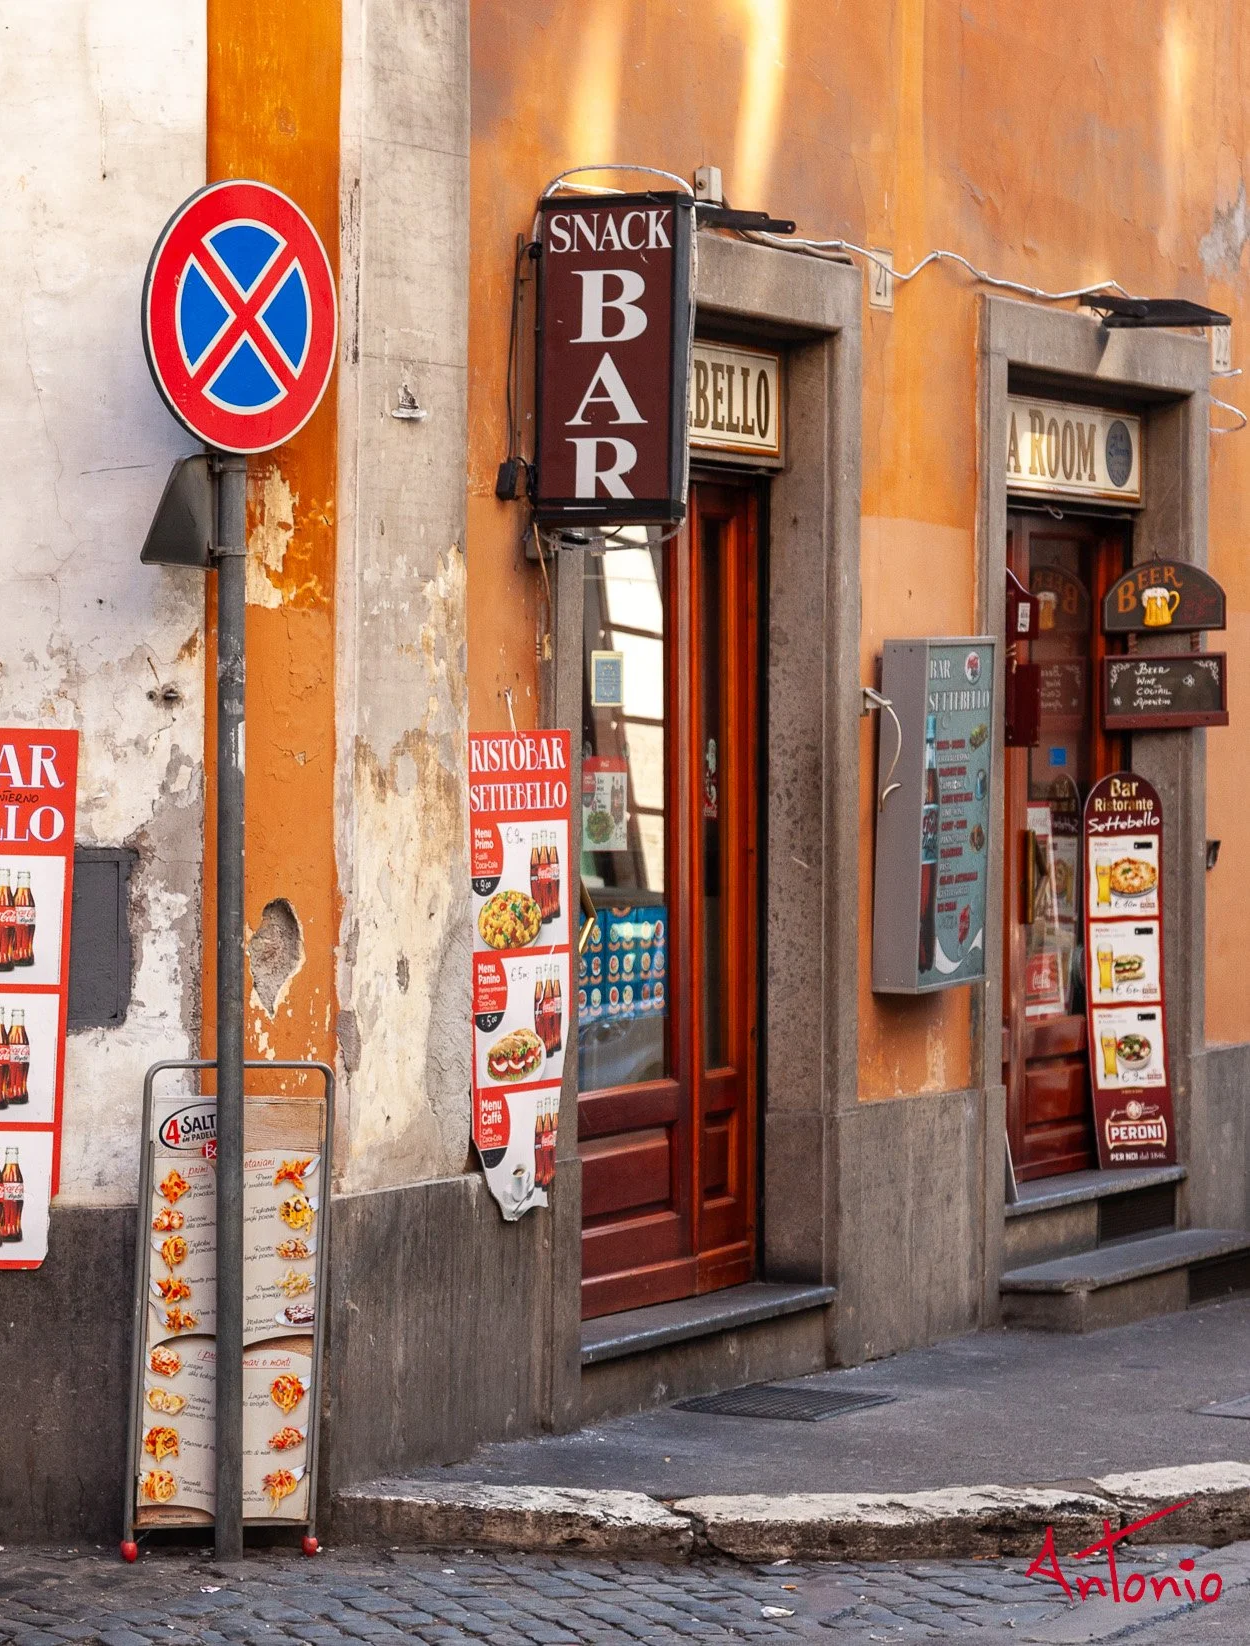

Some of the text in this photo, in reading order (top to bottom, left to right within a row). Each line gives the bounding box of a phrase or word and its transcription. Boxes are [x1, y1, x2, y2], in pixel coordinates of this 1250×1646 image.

[550, 209, 672, 254] SNACK
[564, 269, 648, 509] BAR
[687, 359, 770, 439] BELLO
[1029, 408, 1097, 482] ROOM
[1117, 566, 1183, 613] BEER
[930, 659, 951, 679] BAR
[1110, 778, 1139, 797] Bar
[470, 781, 568, 813] SETTEBELLO
[1094, 798, 1154, 812] Ristorante
[1088, 812, 1160, 834] Settebello
[474, 828, 492, 839] Menu
[475, 839, 494, 850] Primo
[475, 861, 498, 870] Coca-Cola
[477, 963, 496, 974] Menu
[478, 974, 501, 985] Panino
[481, 1099, 502, 1112] Menu
[481, 1111, 503, 1125] Caffè
[165, 1114, 216, 1144] 4 SALT
[191, 1131, 217, 1141] PADELL
[1111, 1124, 1163, 1140] PERONI
[1111, 1152, 1124, 1161] PER
